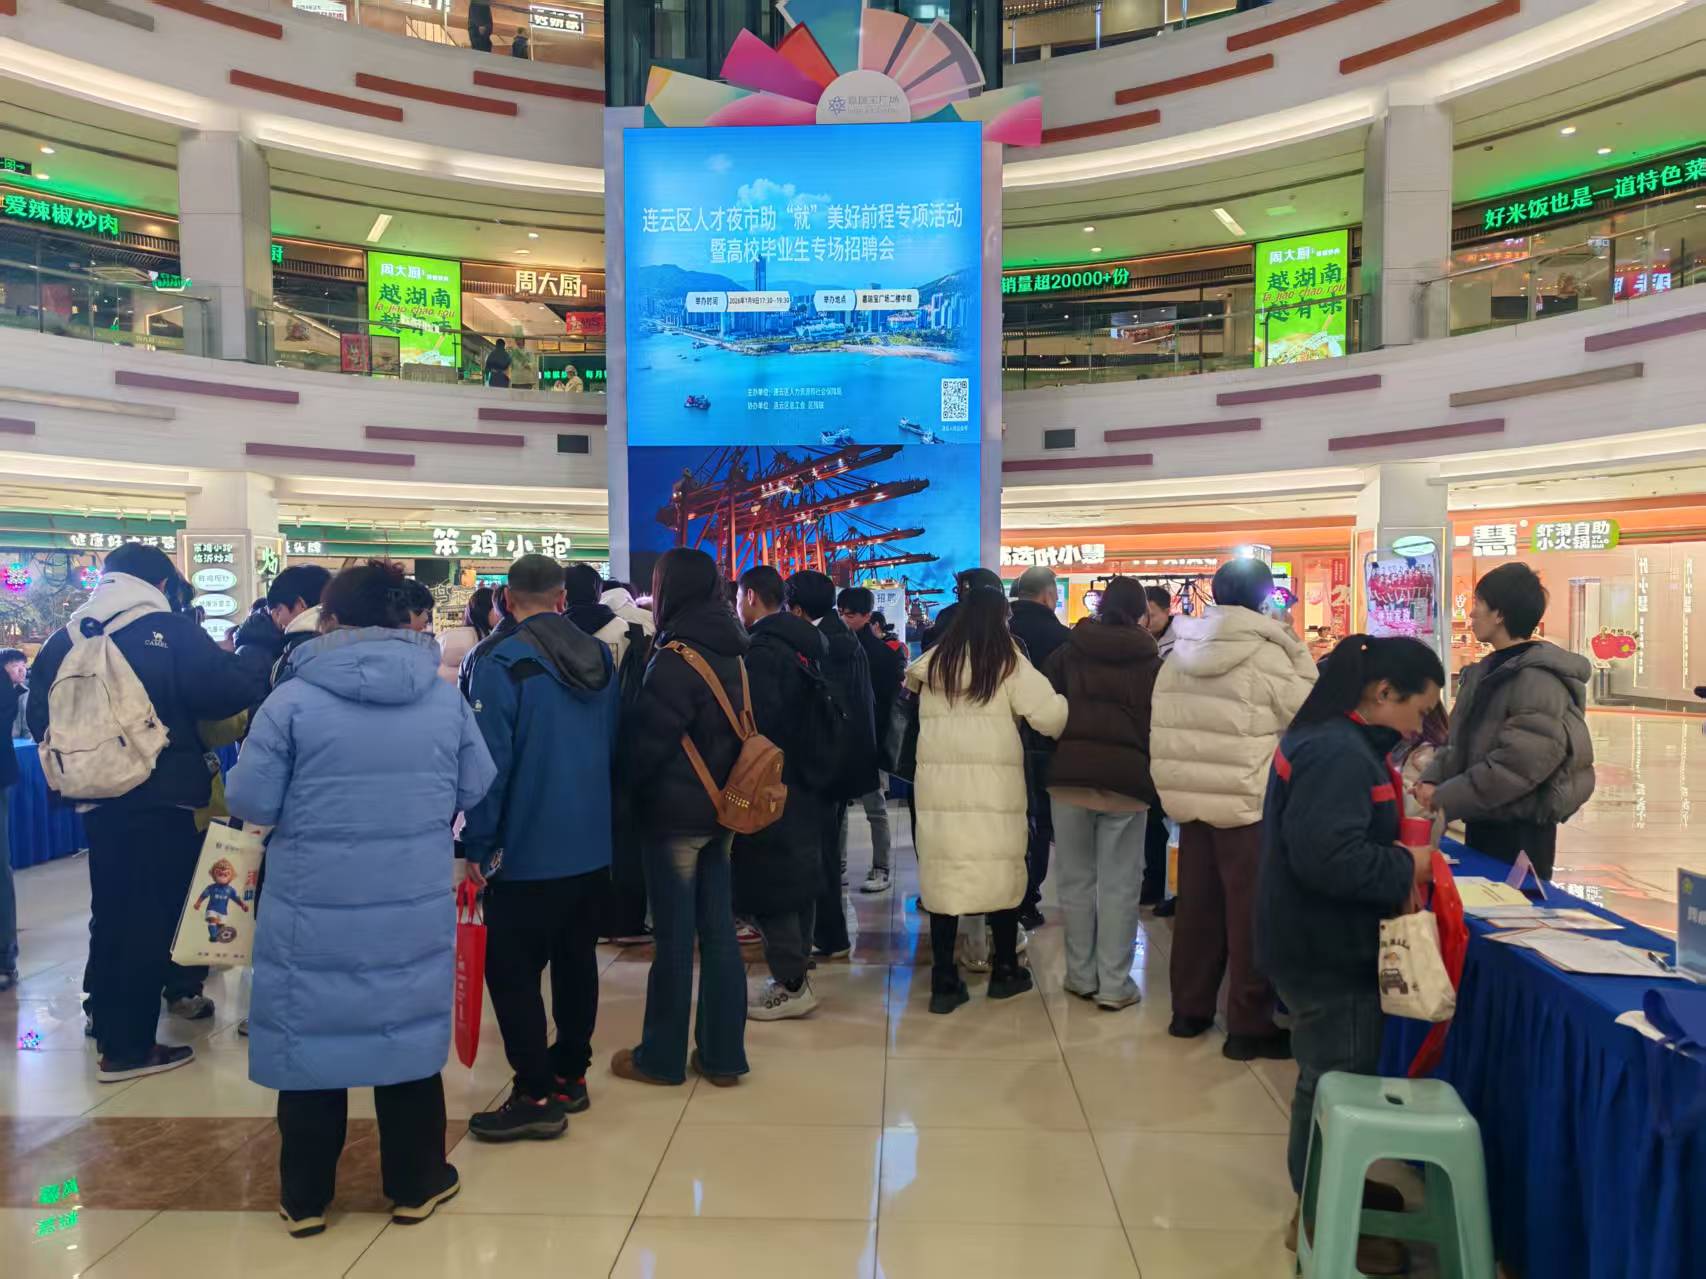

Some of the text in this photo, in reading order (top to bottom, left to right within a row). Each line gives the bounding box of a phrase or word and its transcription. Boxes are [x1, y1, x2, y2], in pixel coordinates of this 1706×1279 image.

[1485, 158, 1706, 230] 好米饭也是一道特色菜
[4, 194, 119, 235] 爱辣椒炒肉
[710, 236, 895, 263] 暨高校毕业生专场招聘会
[1270, 246, 1310, 264] 周大厨
[381, 263, 422, 280] 周大厨
[515, 270, 581, 297] 周大厨
[1001, 267, 1129, 293] 销量超20000+份
[1267, 262, 1341, 291] 越湖南
[378, 283, 450, 309] 越湖南
[1536, 520, 1610, 538] 虾滑自助
[433, 527, 571, 559] 笨鸡小跑
[1536, 535, 1590, 551] 小火锅
